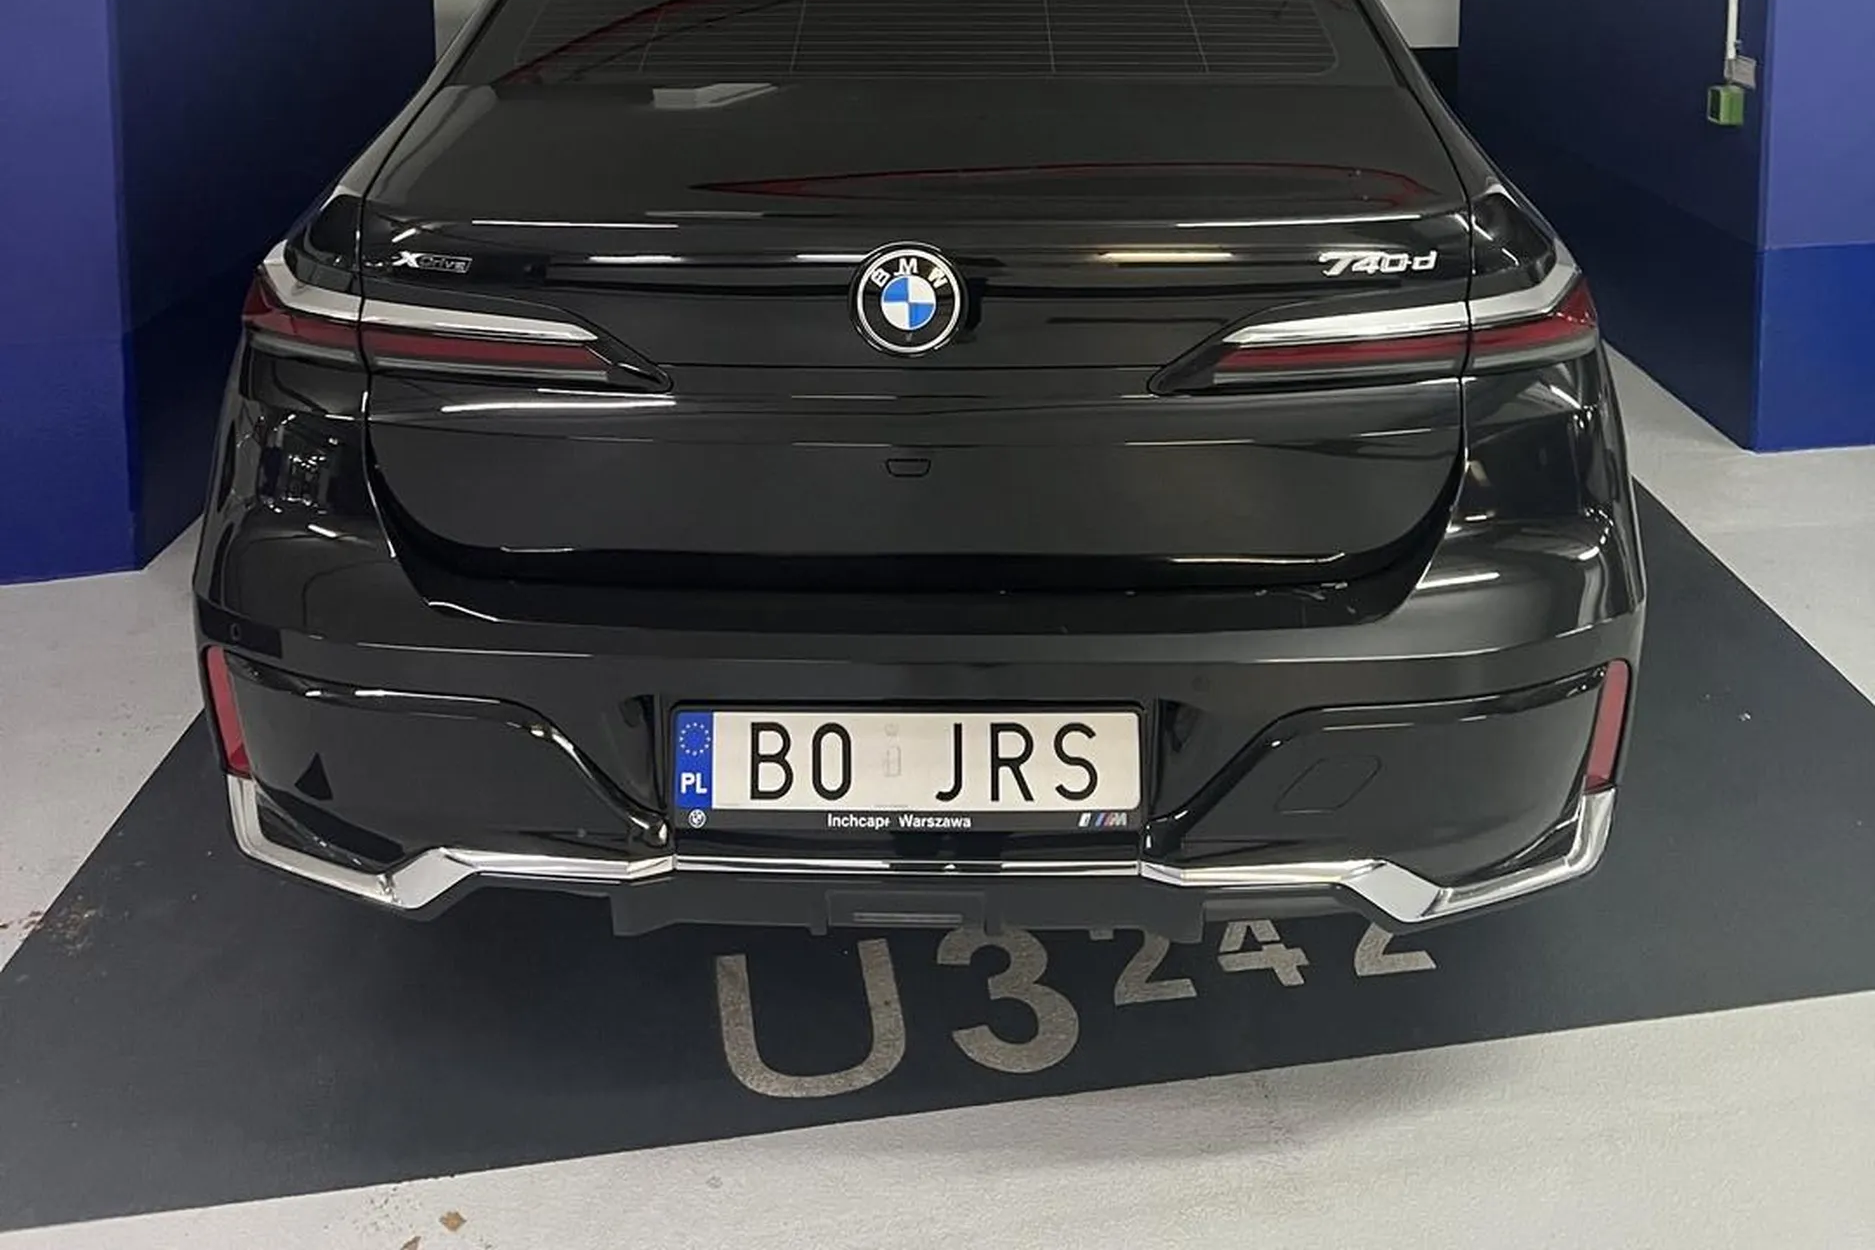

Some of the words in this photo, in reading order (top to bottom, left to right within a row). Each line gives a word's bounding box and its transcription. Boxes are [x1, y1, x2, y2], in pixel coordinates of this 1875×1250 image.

[870, 257, 948, 289] BMW
[1318, 251, 1437, 276] 740d
[935, 722, 1098, 802] JRS
[680, 772, 708, 794] PL
[899, 814, 971, 828] Warszawa
